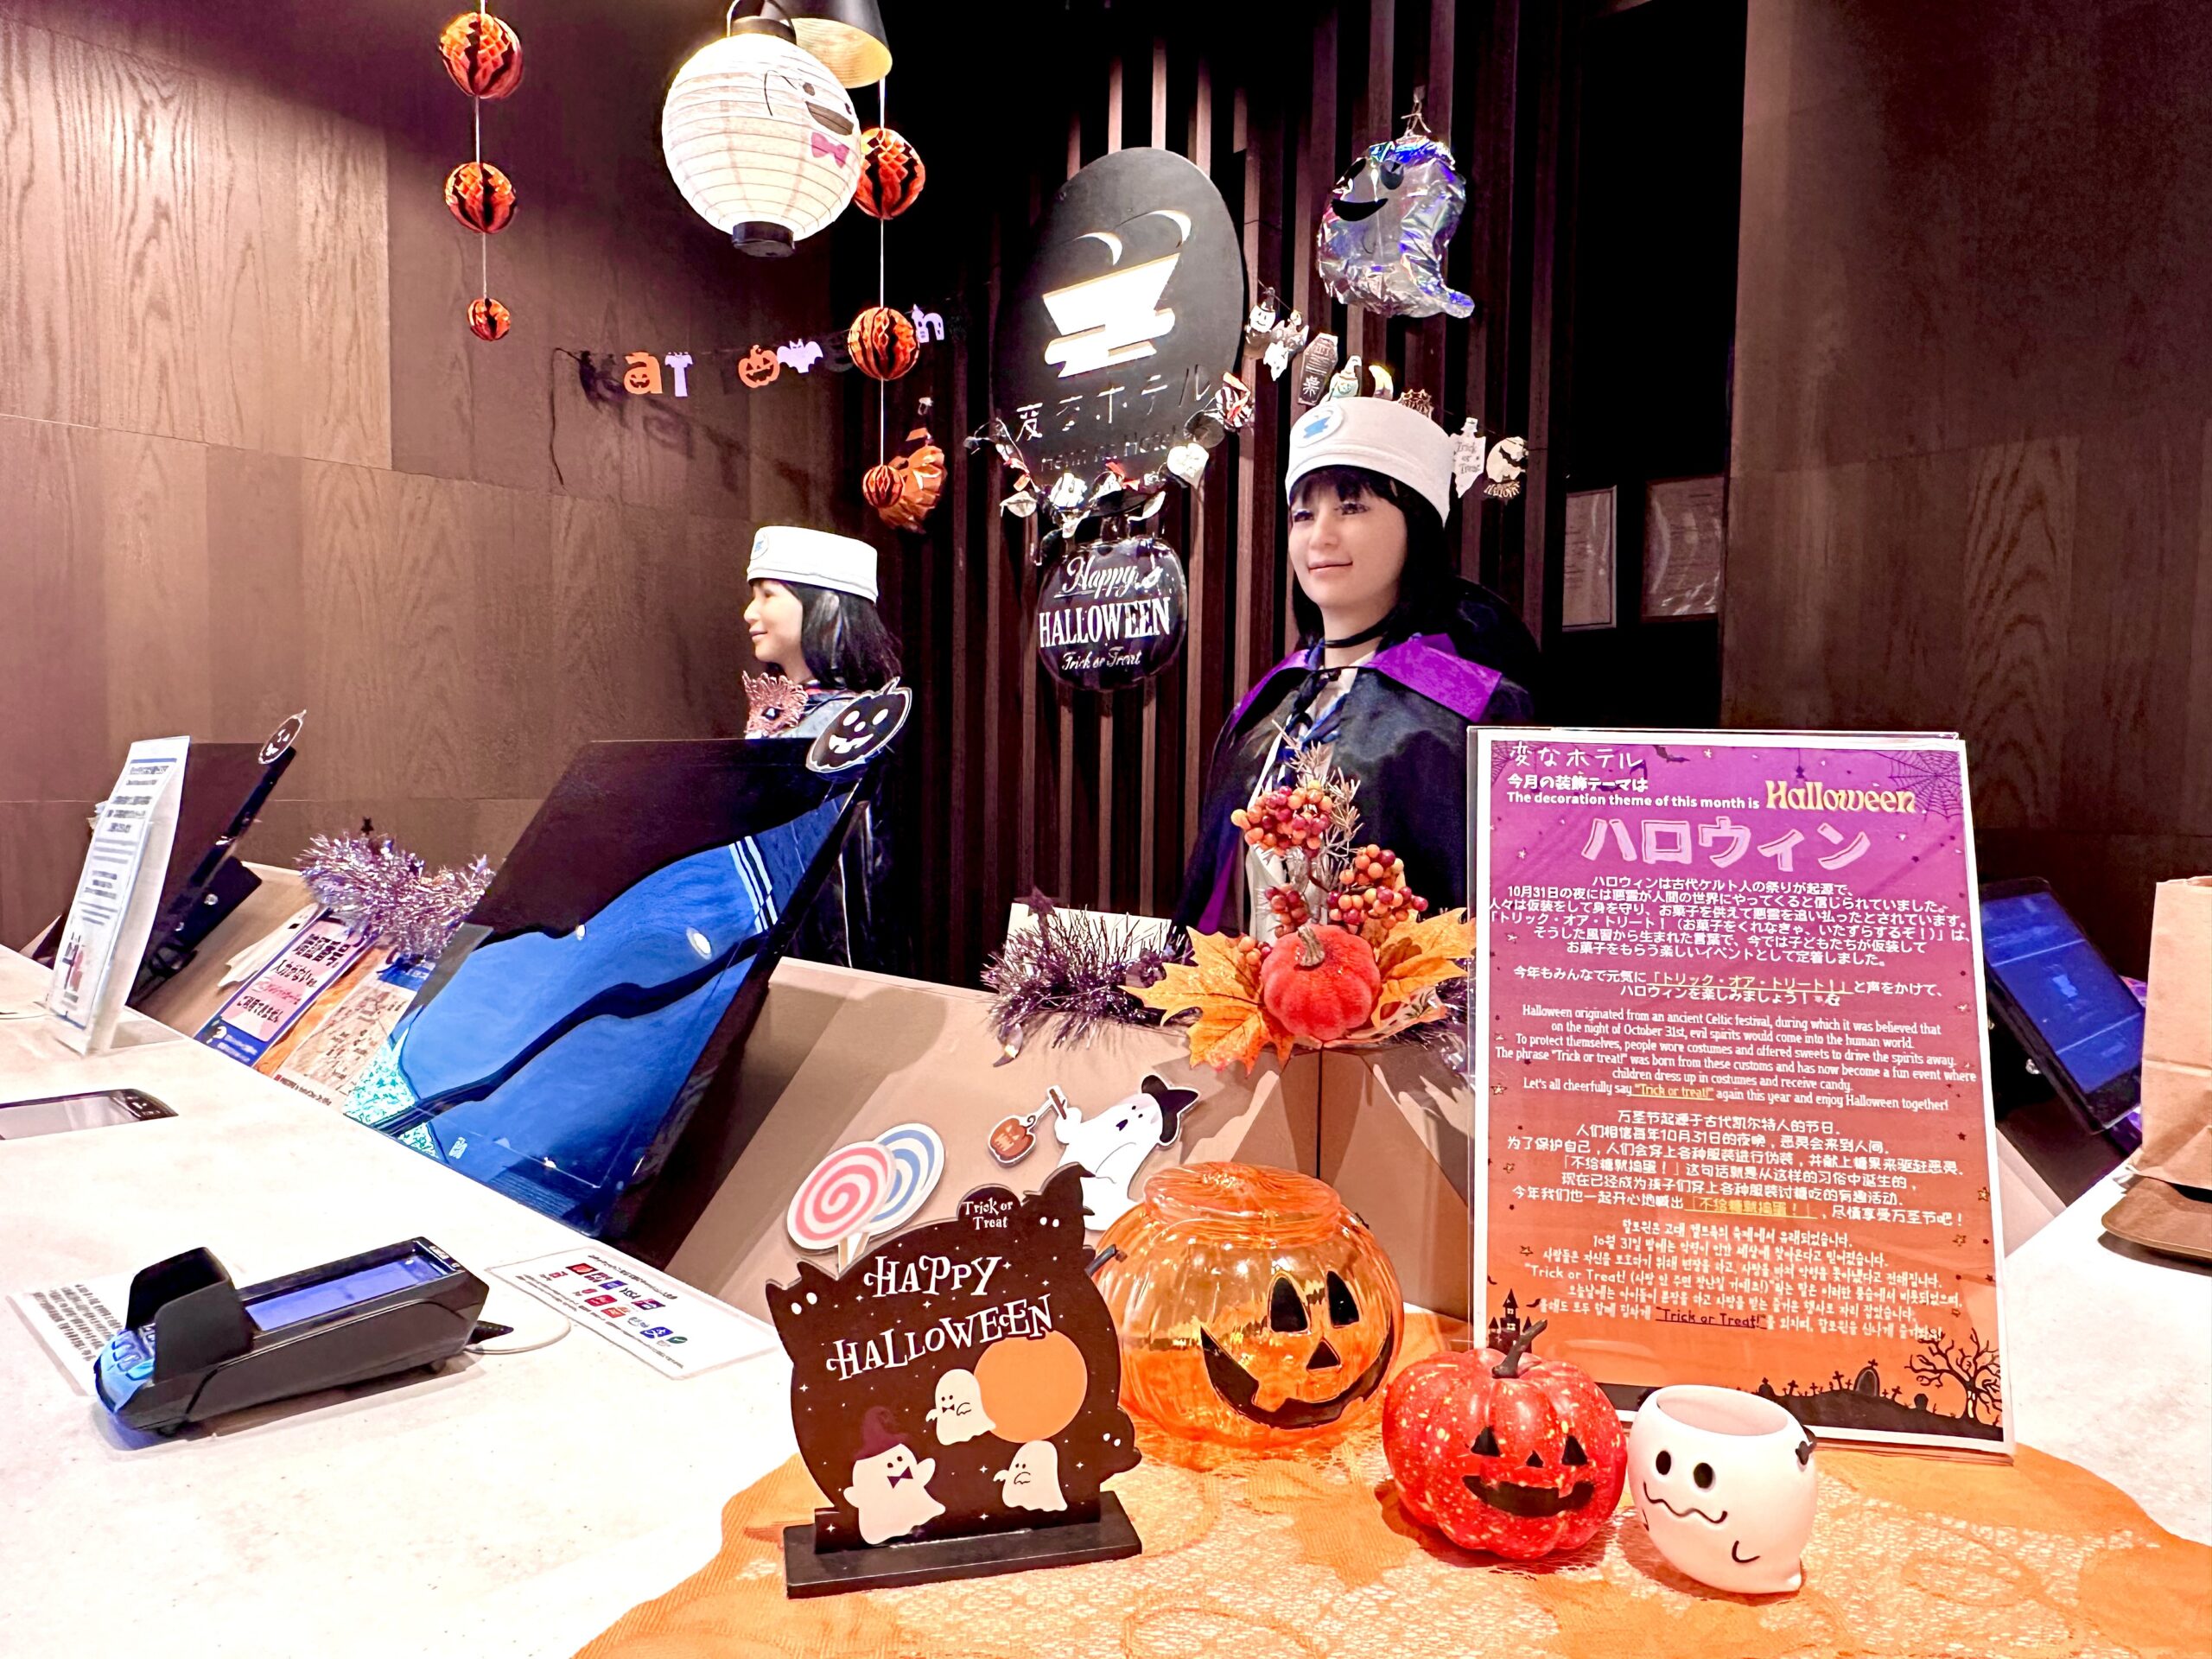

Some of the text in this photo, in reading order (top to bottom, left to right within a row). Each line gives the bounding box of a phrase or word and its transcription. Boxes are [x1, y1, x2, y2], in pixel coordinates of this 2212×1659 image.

[1062, 555, 1139, 599] Happy
[1039, 597, 1170, 648] HALLOWEEN
[1062, 651, 1092, 671] Trick
[1510, 741, 1643, 769] 変なホテル
[1507, 773, 1649, 792] 今月の装飾テーマは
[1507, 780, 1916, 813] The decoration theme of this month is Halloween
[1581, 816, 1871, 872] ハロウィン
[1522, 1004, 1942, 1035] Halloween originated from an ancient Celtic festival, during which it was believed that
[1567, 1020, 1581, 1033] the
[1585, 1022, 1608, 1037] night
[1612, 1023, 1620, 1033] of
[1624, 1024, 1662, 1036] October
[1666, 1027, 1688, 1040] 31st,
[1690, 1027, 1707, 1039] evil
[1710, 1029, 1740, 1041] spirits
[1744, 1030, 1773, 1041] would
[1777, 1034, 1802, 1043] come
[1805, 1031, 1823, 1044] into
[1827, 1033, 1842, 1045] the
[1846, 1034, 1879, 1046] human
[1883, 1036, 1915, 1049] world.
[1496, 1046, 1513, 1058] The
[1516, 1048, 1549, 1061] phrase
[1583, 1053, 1594, 1062] or
[1630, 1056, 1649, 1065] was
[1652, 1054, 1675, 1066] born
[1678, 1055, 1700, 1067] from
[1704, 1057, 1730, 1069] these
[1734, 1060, 1773, 1071] customs
[1777, 1061, 1795, 1072] and
[1797, 1061, 1815, 1073] has
[1818, 1065, 1839, 1074] now
[1841, 1063, 1880, 1077] become
[1884, 1069, 1890, 1077] a
[1892, 1065, 1910, 1078] fun
[1913, 1070, 1941, 1080] event
[1944, 1070, 1976, 1082] where
[1516, 1033, 1956, 1070] To protect themselves, people wore costumes and offered sweets to drive the spirits away.
[1524, 1077, 1547, 1089] Let's
[1549, 1078, 1560, 1090] all
[1563, 1078, 1612, 1096] cheerfully
[1614, 1085, 1632, 1096] say
[1669, 1088, 1679, 1096] or
[1716, 1088, 1744, 1102] again
[1747, 1089, 1765, 1101] this
[1768, 1093, 1791, 1105] year
[1794, 1092, 1813, 1103] and
[1816, 1093, 1843, 1109] enjoy
[1846, 1092, 1899, 1109] Halloween
[1902, 1097, 1948, 1112] together!
[1612, 1066, 1853, 1094] children dress up in costumes and receive candy.
[962, 1197, 1014, 1215] Trick or
[973, 1216, 1008, 1230] Treat
[864, 1255, 1002, 1297] HAPPY
[1586, 1269, 1625, 1283] Treat!
[826, 1294, 1053, 1382] HALLOWEEN
